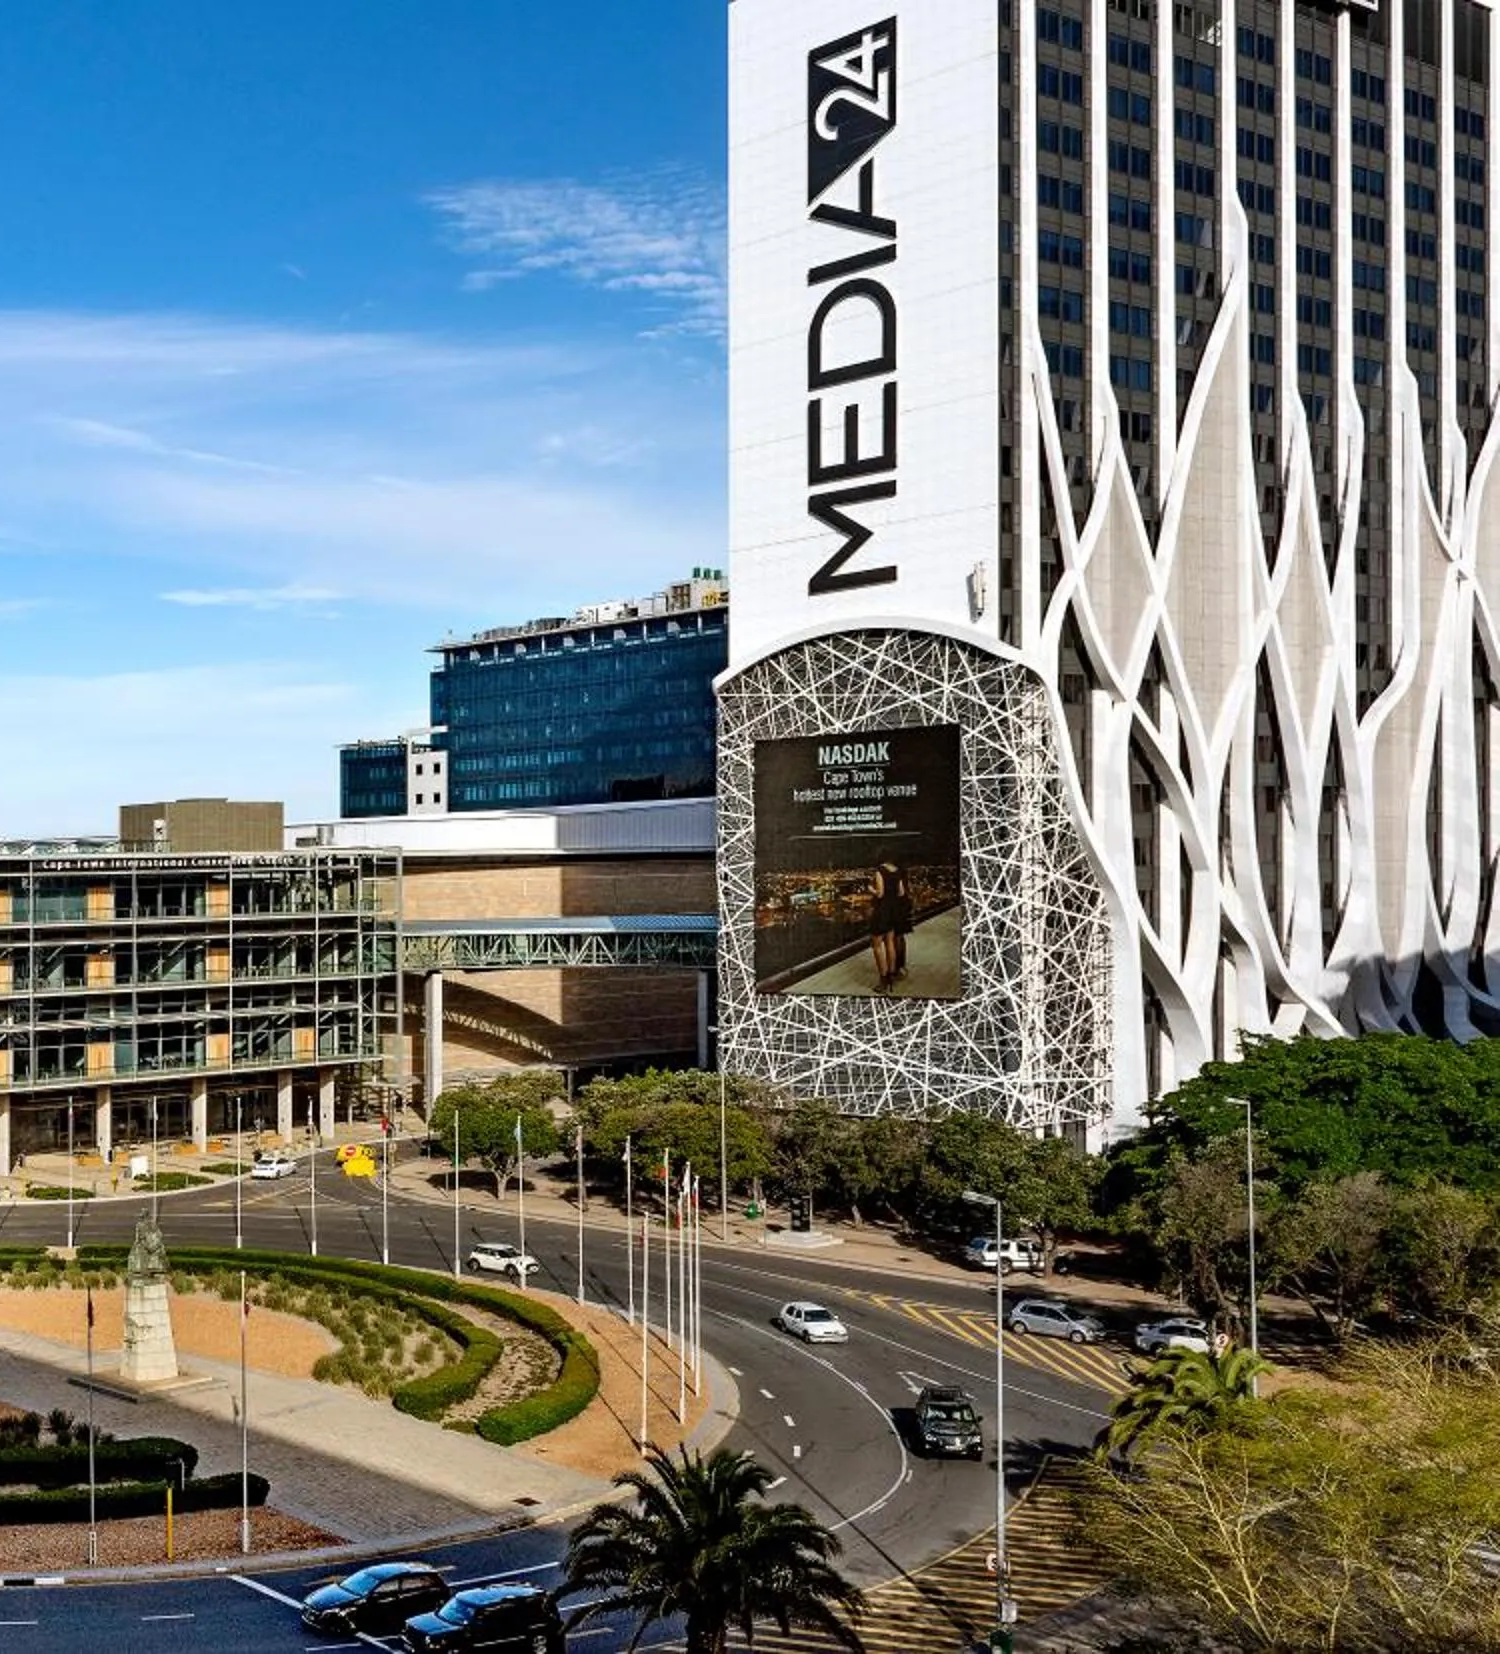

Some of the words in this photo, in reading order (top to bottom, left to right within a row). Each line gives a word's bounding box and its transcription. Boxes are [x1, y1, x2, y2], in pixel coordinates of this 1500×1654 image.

[818, 742, 890, 765] NASDAK
[823, 771, 849, 786] Cape
[851, 768, 885, 783] Town's
